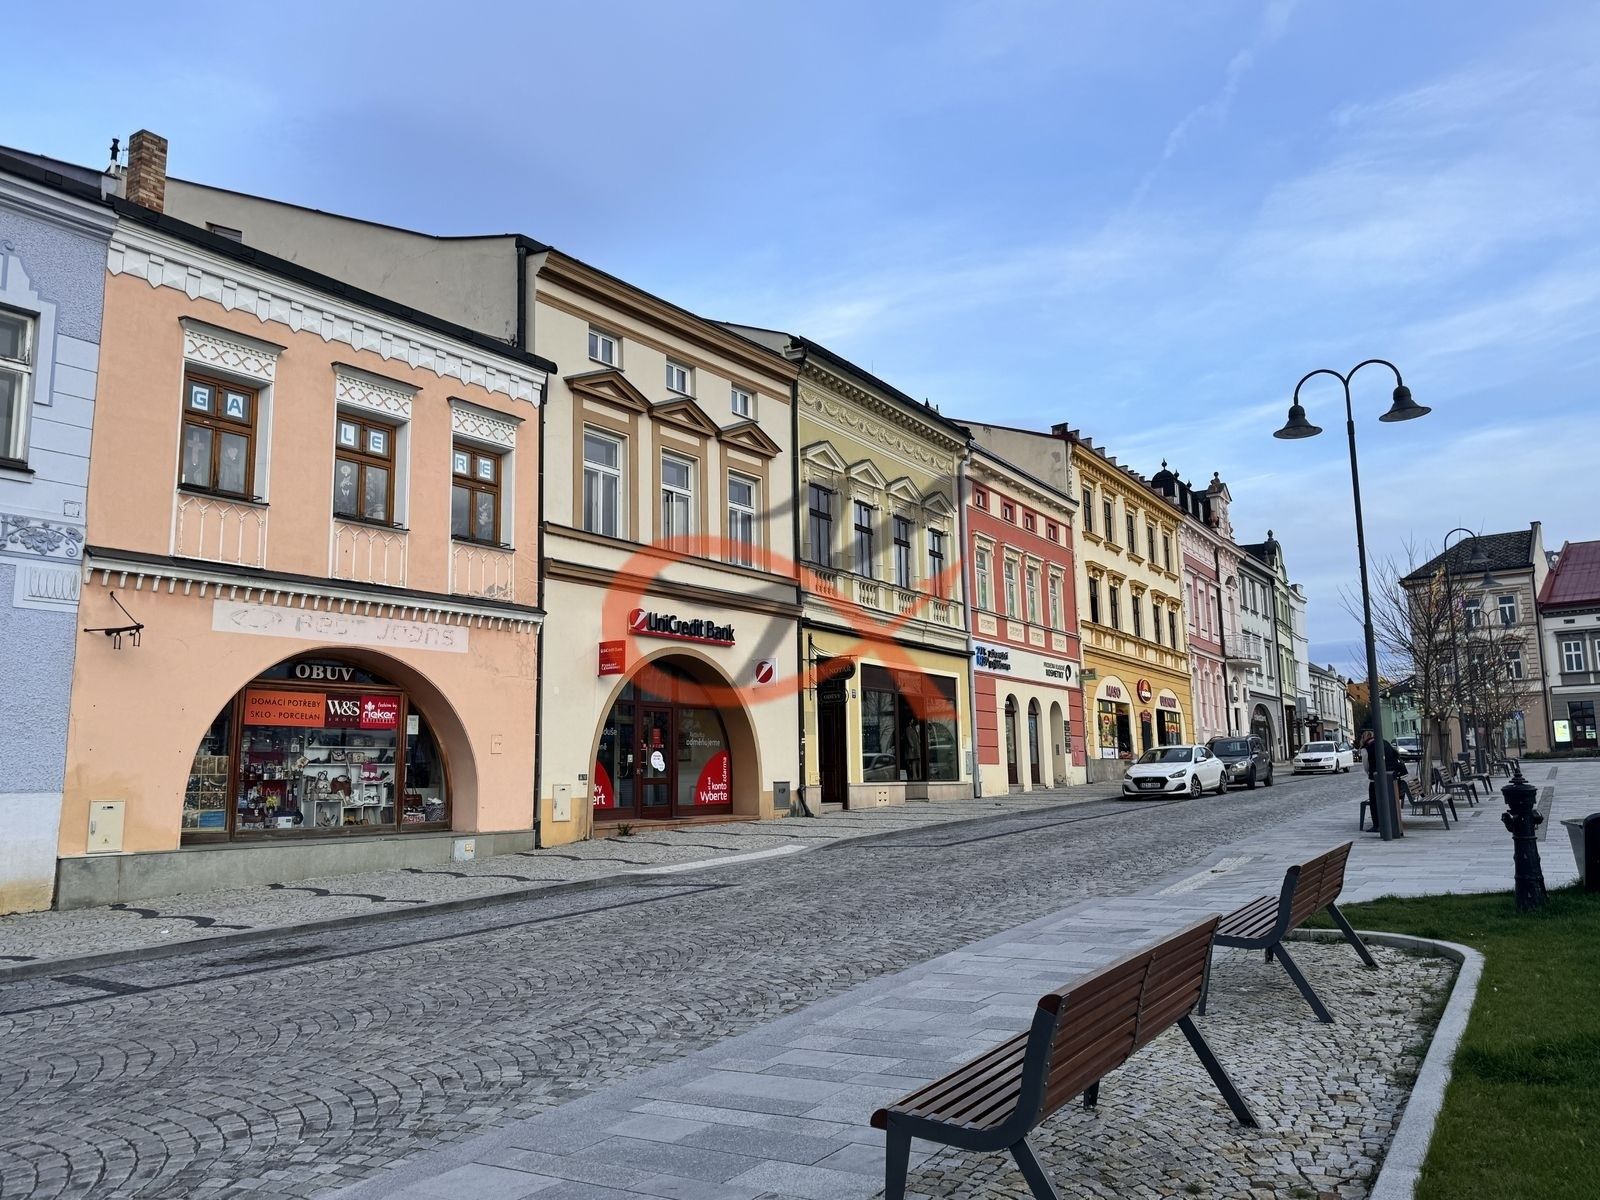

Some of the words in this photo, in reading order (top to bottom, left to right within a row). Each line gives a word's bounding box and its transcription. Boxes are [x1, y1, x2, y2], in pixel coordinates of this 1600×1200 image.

[646, 612, 704, 637] UniCredit
[703, 620, 736, 641] Bank
[295, 664, 354, 681] OBUV
[1105, 685, 1121, 699] MASO
[251, 696, 286, 707] DOMÁCÍ
[287, 697, 321, 708] POTŘEBY
[327, 699, 360, 716] W&S
[250, 710, 271, 719] SKLO
[278, 711, 320, 721] PORCELÁN
[362, 709, 396, 719] rieker
[603, 727, 618, 736] duše
[593, 783, 603, 794] ky
[711, 781, 728, 791] konto
[592, 793, 606, 805] ert
[700, 791, 728, 803] Vyberte
